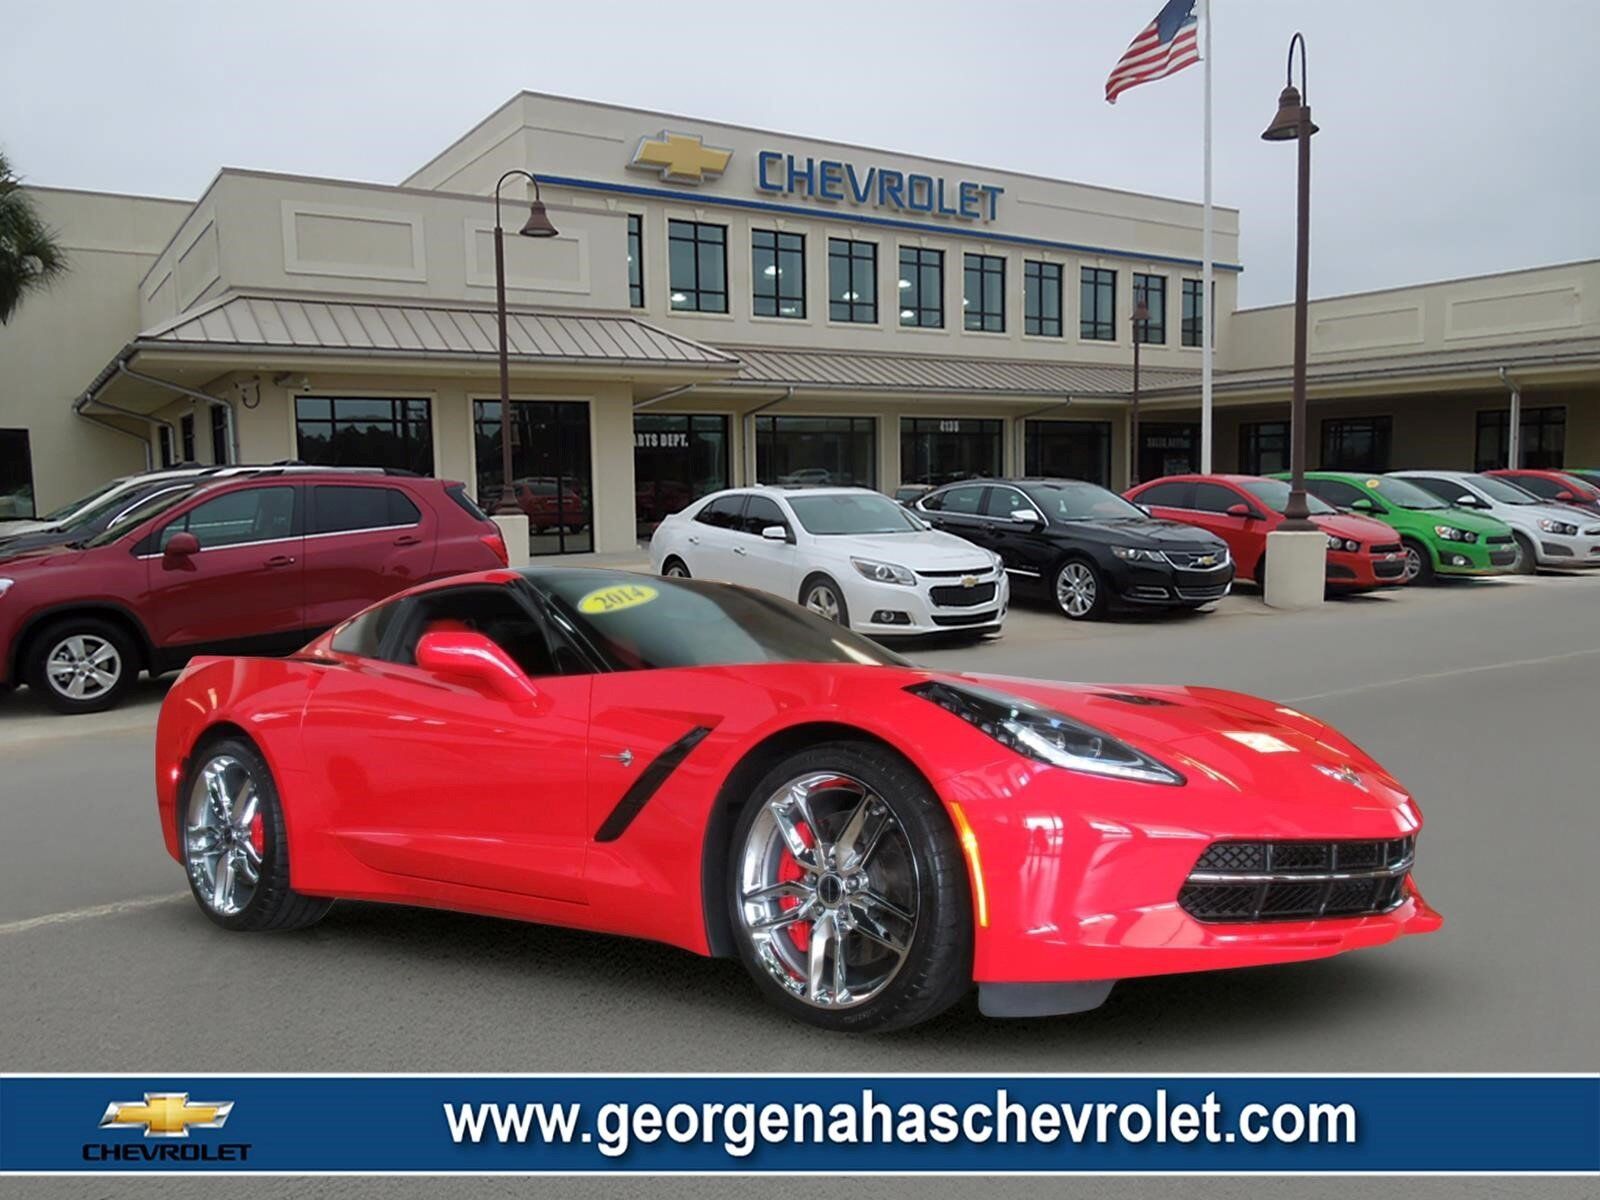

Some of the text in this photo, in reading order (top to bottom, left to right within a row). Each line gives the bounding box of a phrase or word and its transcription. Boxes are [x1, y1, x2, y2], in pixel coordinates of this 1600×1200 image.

[758, 150, 1005, 221] CHEVROLET
[660, 433, 689, 447] DEPT.
[593, 586, 645, 609] 2014
